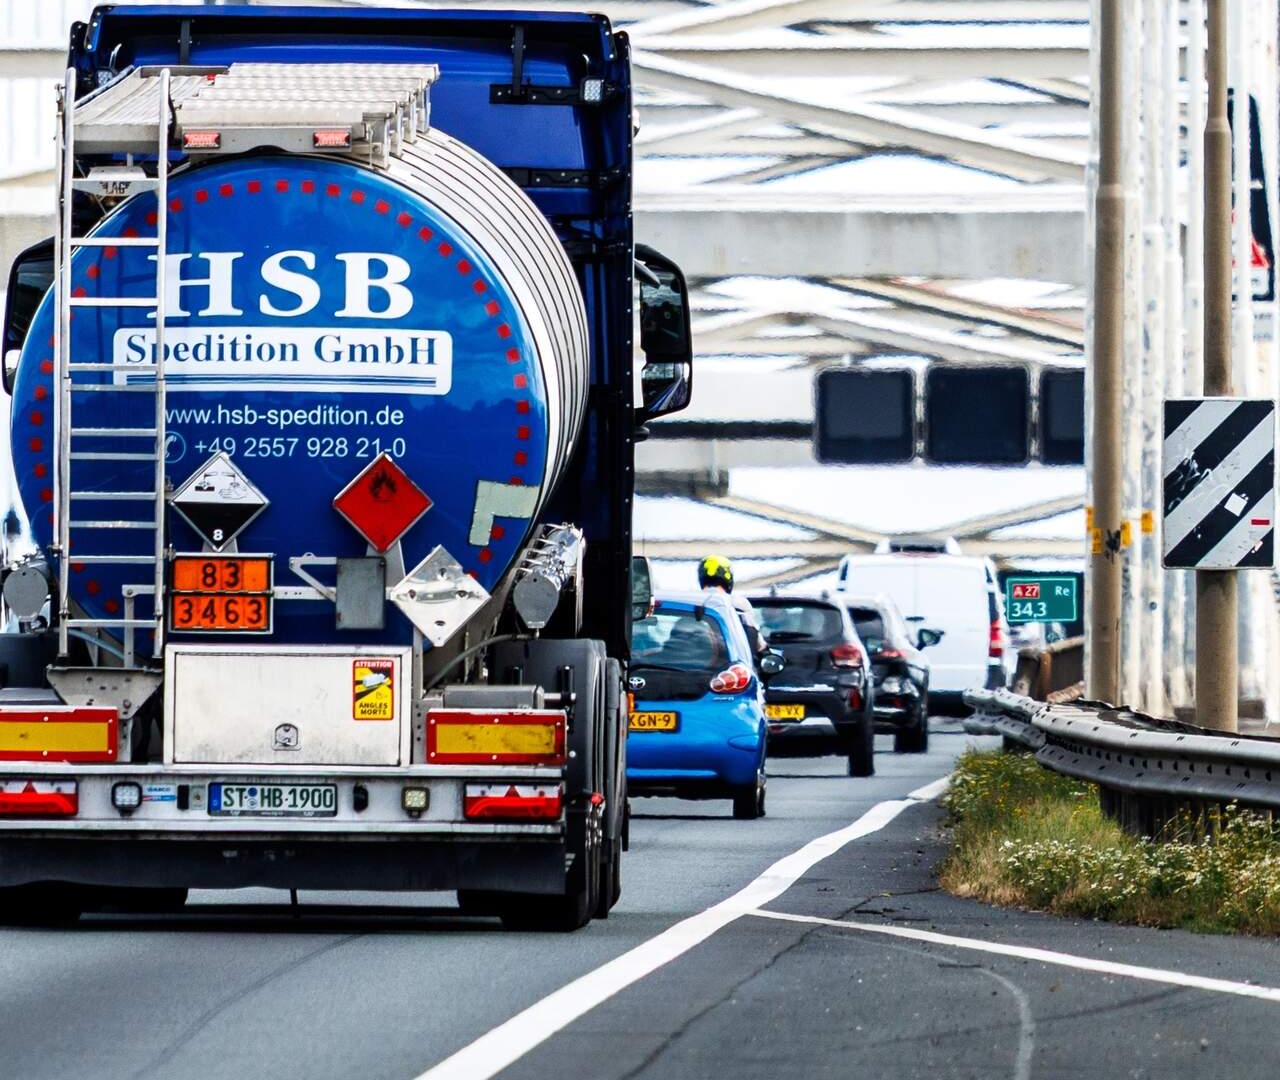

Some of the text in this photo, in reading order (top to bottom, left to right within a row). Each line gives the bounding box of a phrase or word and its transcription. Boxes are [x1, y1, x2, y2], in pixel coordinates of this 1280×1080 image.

[146, 250, 414, 319] HSB
[127, 333, 439, 365] Spedition GmbH
[194, 437, 406, 458] +49 2557 928 21-0
[212, 529, 224, 541] 8
[201, 561, 242, 589] 83
[1055, 585, 1071, 597] Re
[178, 597, 264, 626] 3463
[1011, 601, 1048, 618] 34,3
[354, 660, 393, 668] ATTENTION
[359, 702, 388, 710] ANGLES
